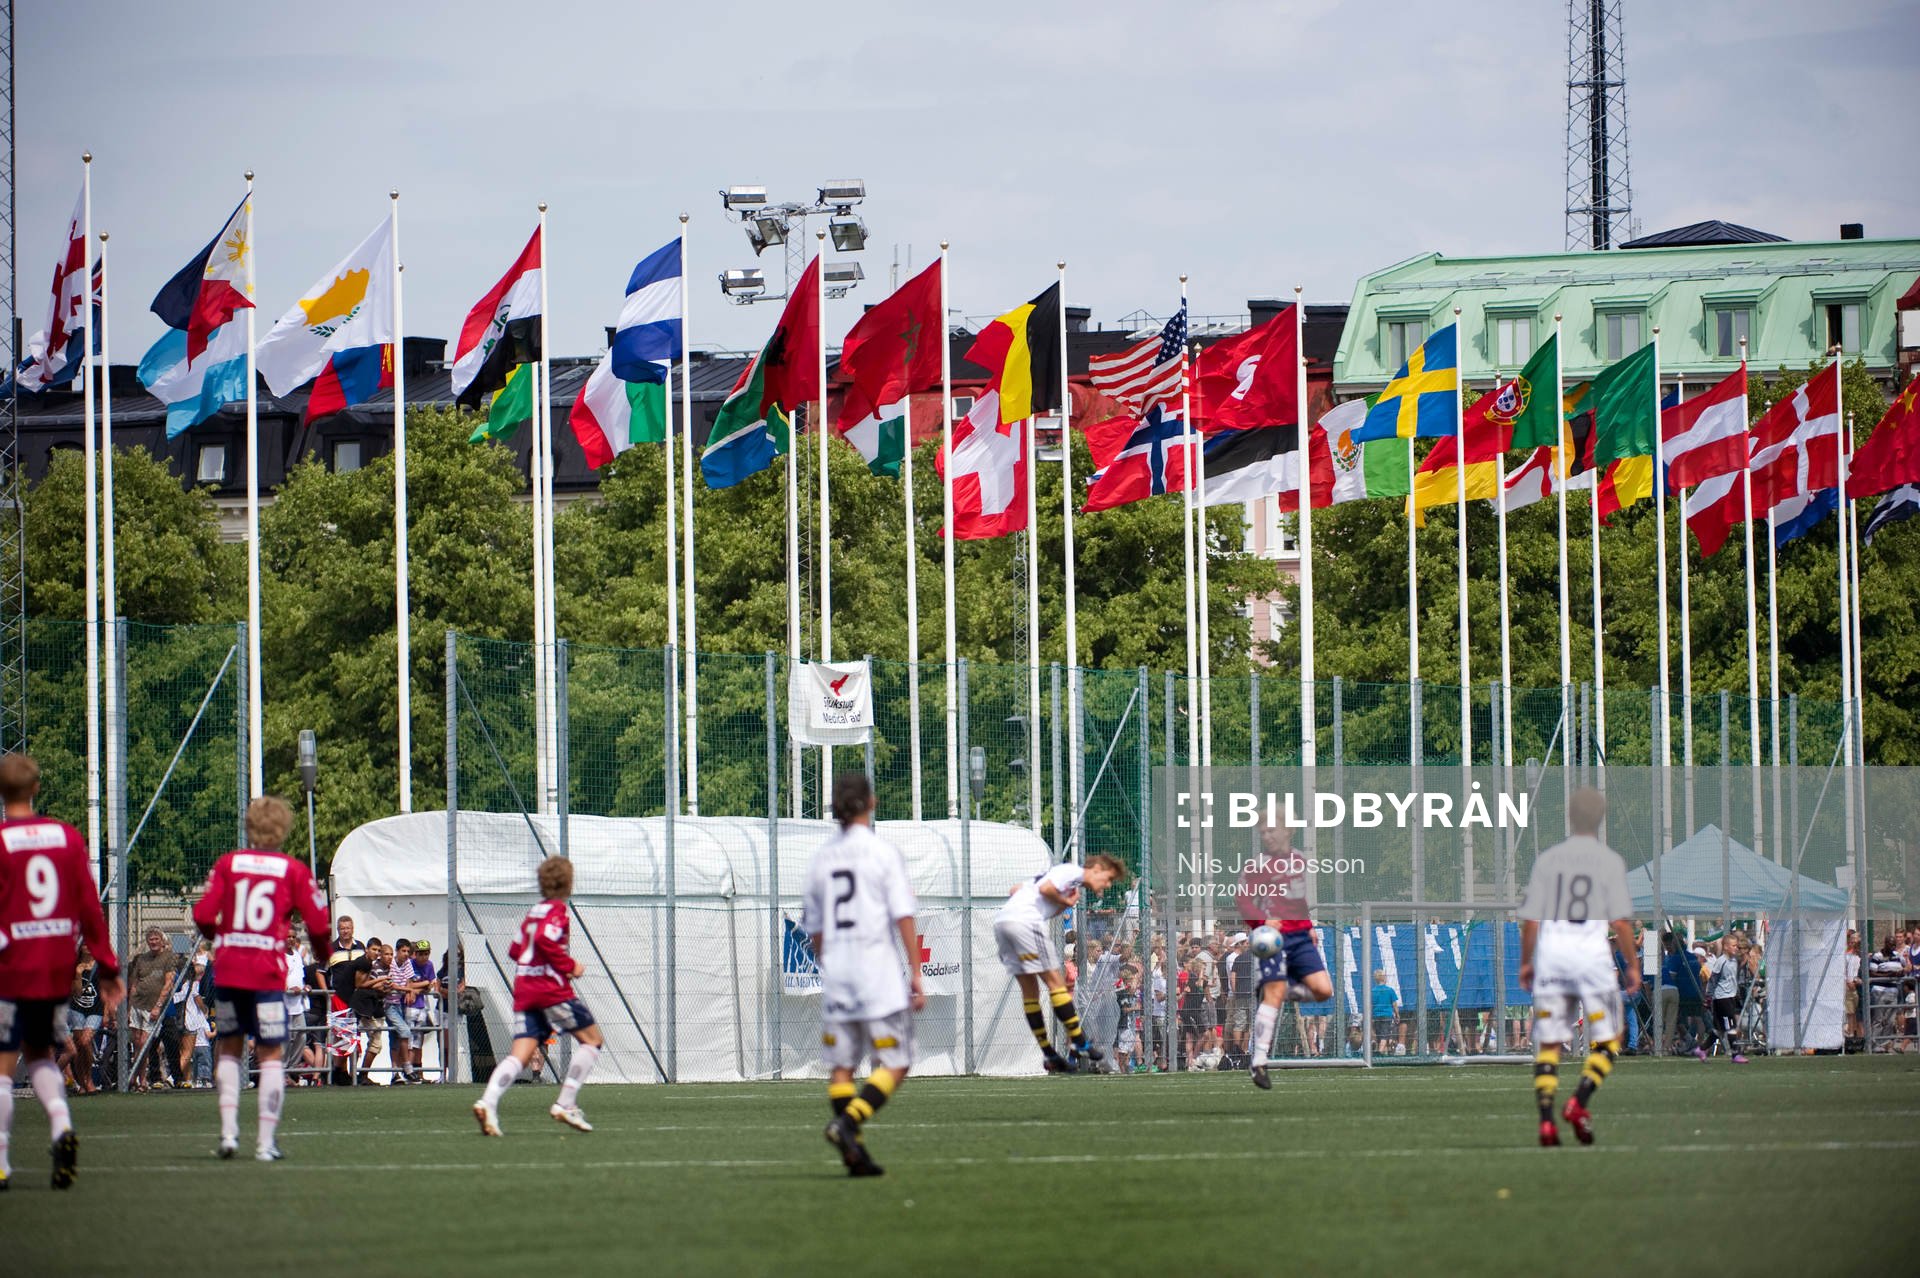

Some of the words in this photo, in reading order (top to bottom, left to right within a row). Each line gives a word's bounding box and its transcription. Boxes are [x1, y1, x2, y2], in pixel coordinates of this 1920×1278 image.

[26, 854, 59, 918] 9
[232, 878, 276, 932] 16
[831, 869, 856, 930] 2
[1553, 872, 1593, 923] 18
